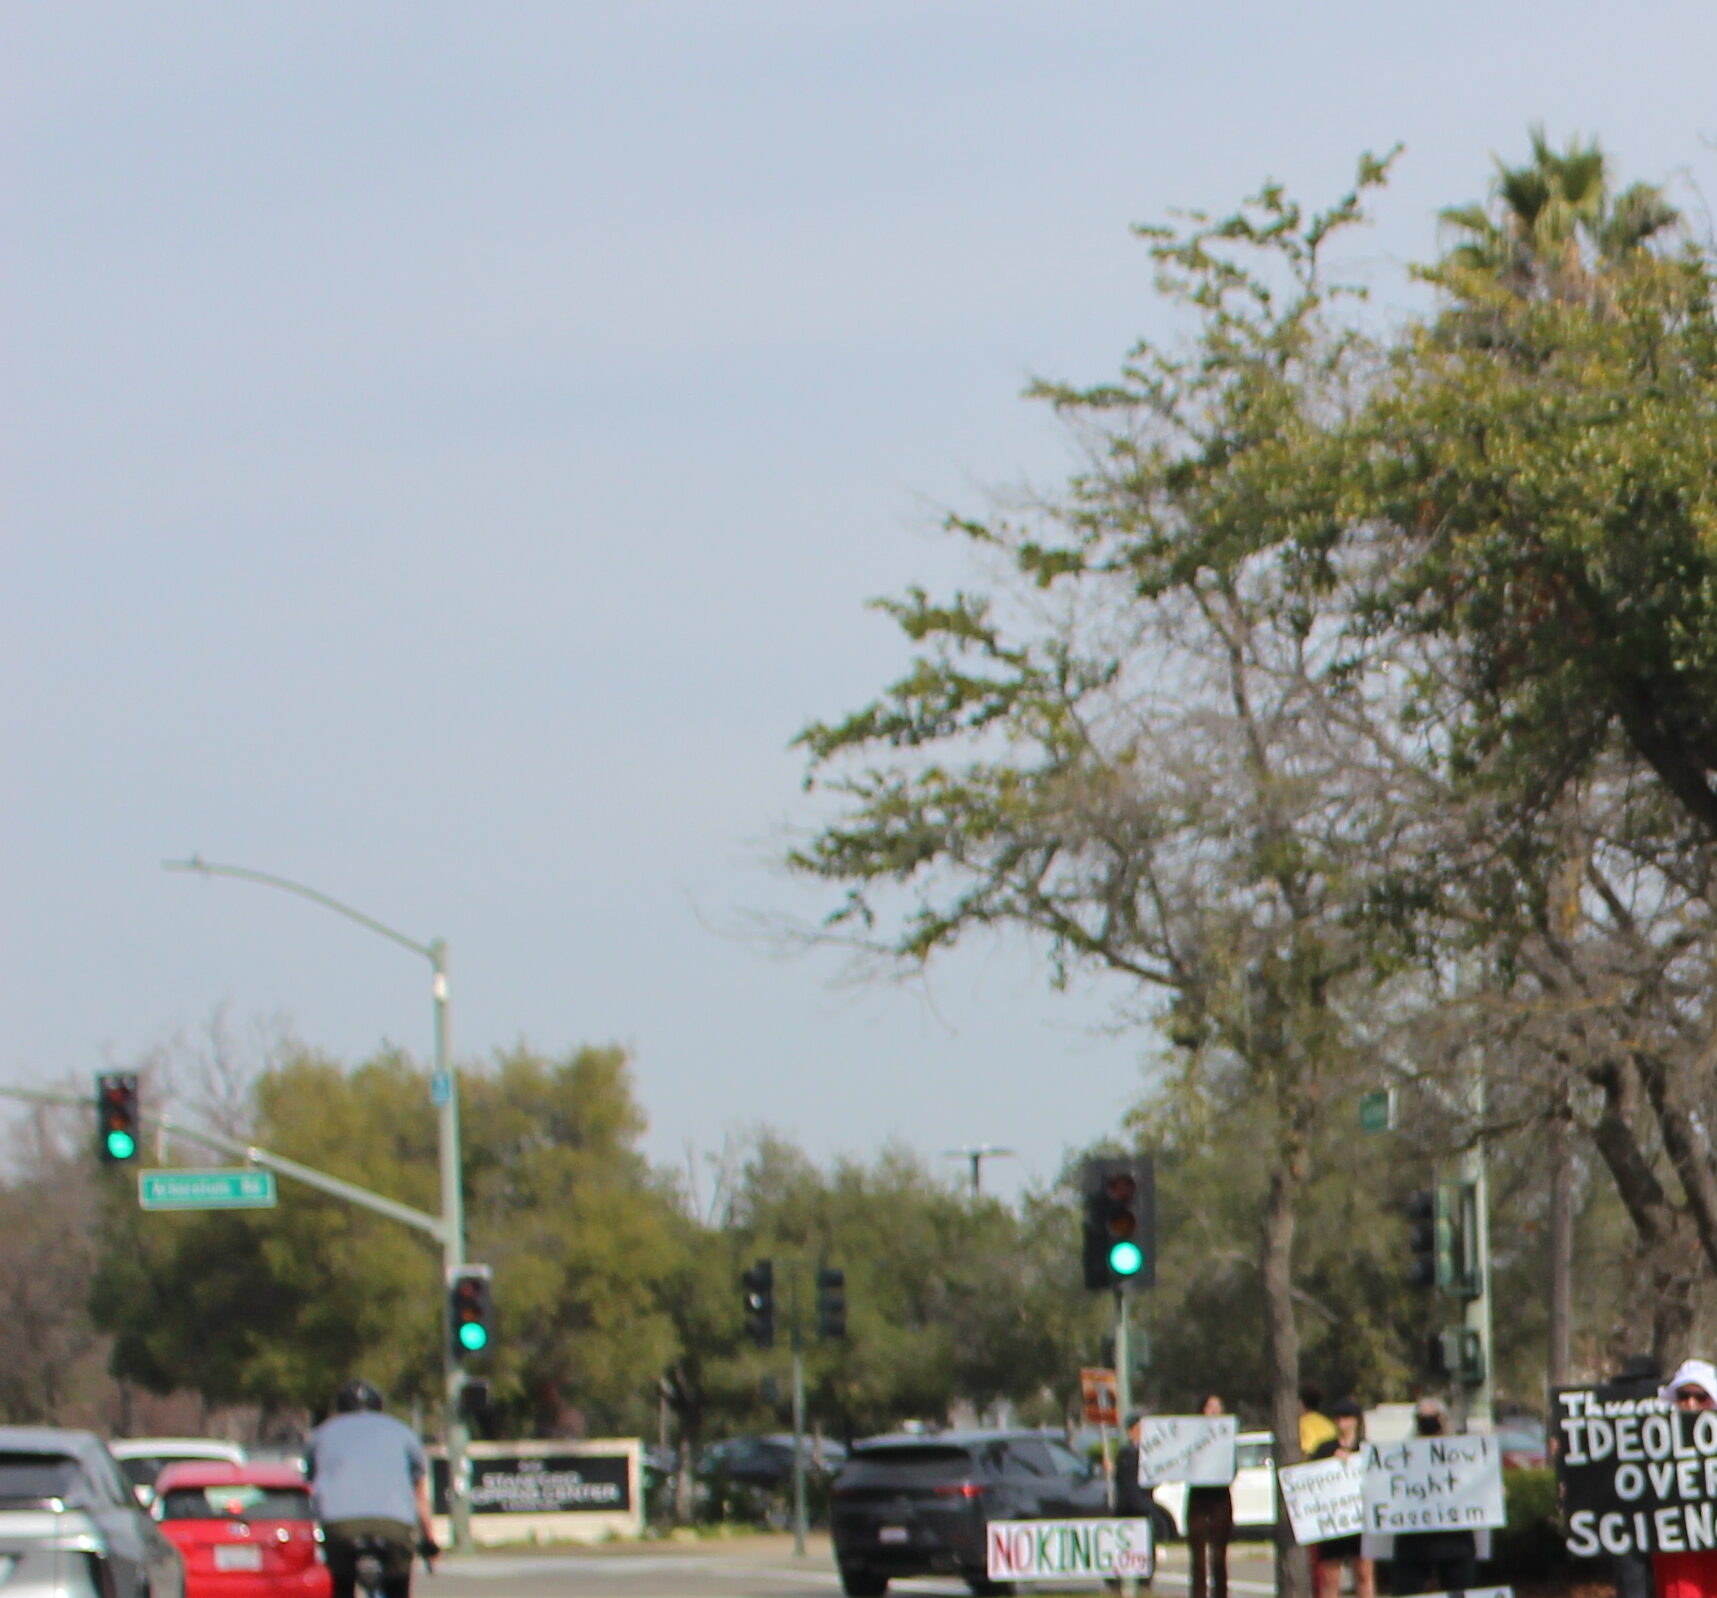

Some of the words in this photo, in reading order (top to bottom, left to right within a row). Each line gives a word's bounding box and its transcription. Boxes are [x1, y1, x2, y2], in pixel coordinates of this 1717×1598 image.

[1366, 1445, 1413, 1473] Act
[1390, 1474, 1459, 1500] Fight
[1373, 1503, 1486, 1530] Fascism
